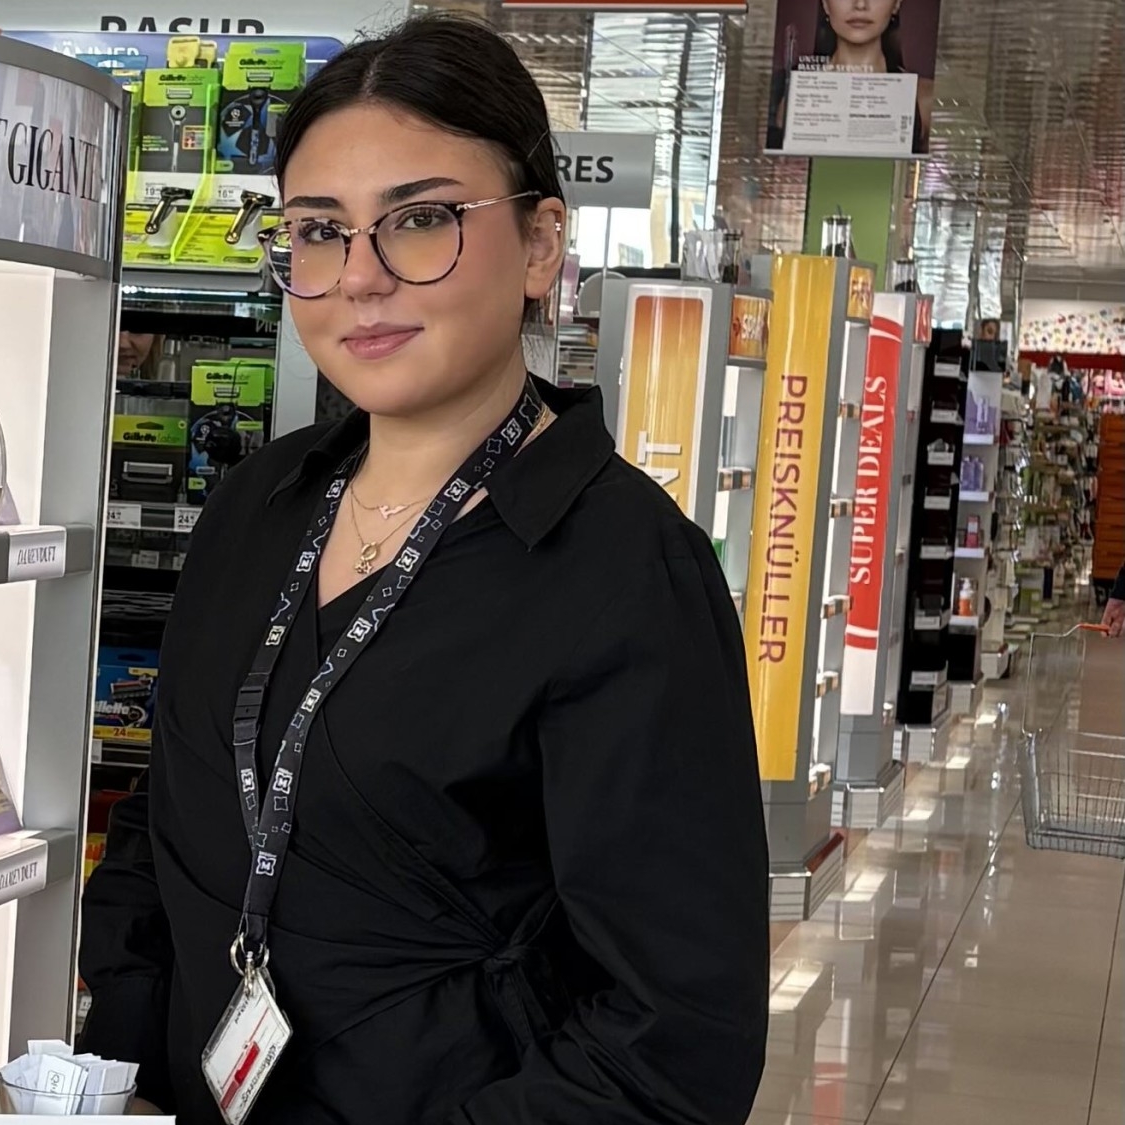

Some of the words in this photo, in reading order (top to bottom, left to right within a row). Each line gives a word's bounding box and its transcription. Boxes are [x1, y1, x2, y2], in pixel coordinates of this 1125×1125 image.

[556, 155, 614, 184] RES
[857, 376, 888, 477] DEALS
[758, 374, 809, 665] PREISKNÜLLER
[849, 487, 879, 586] SUPER
